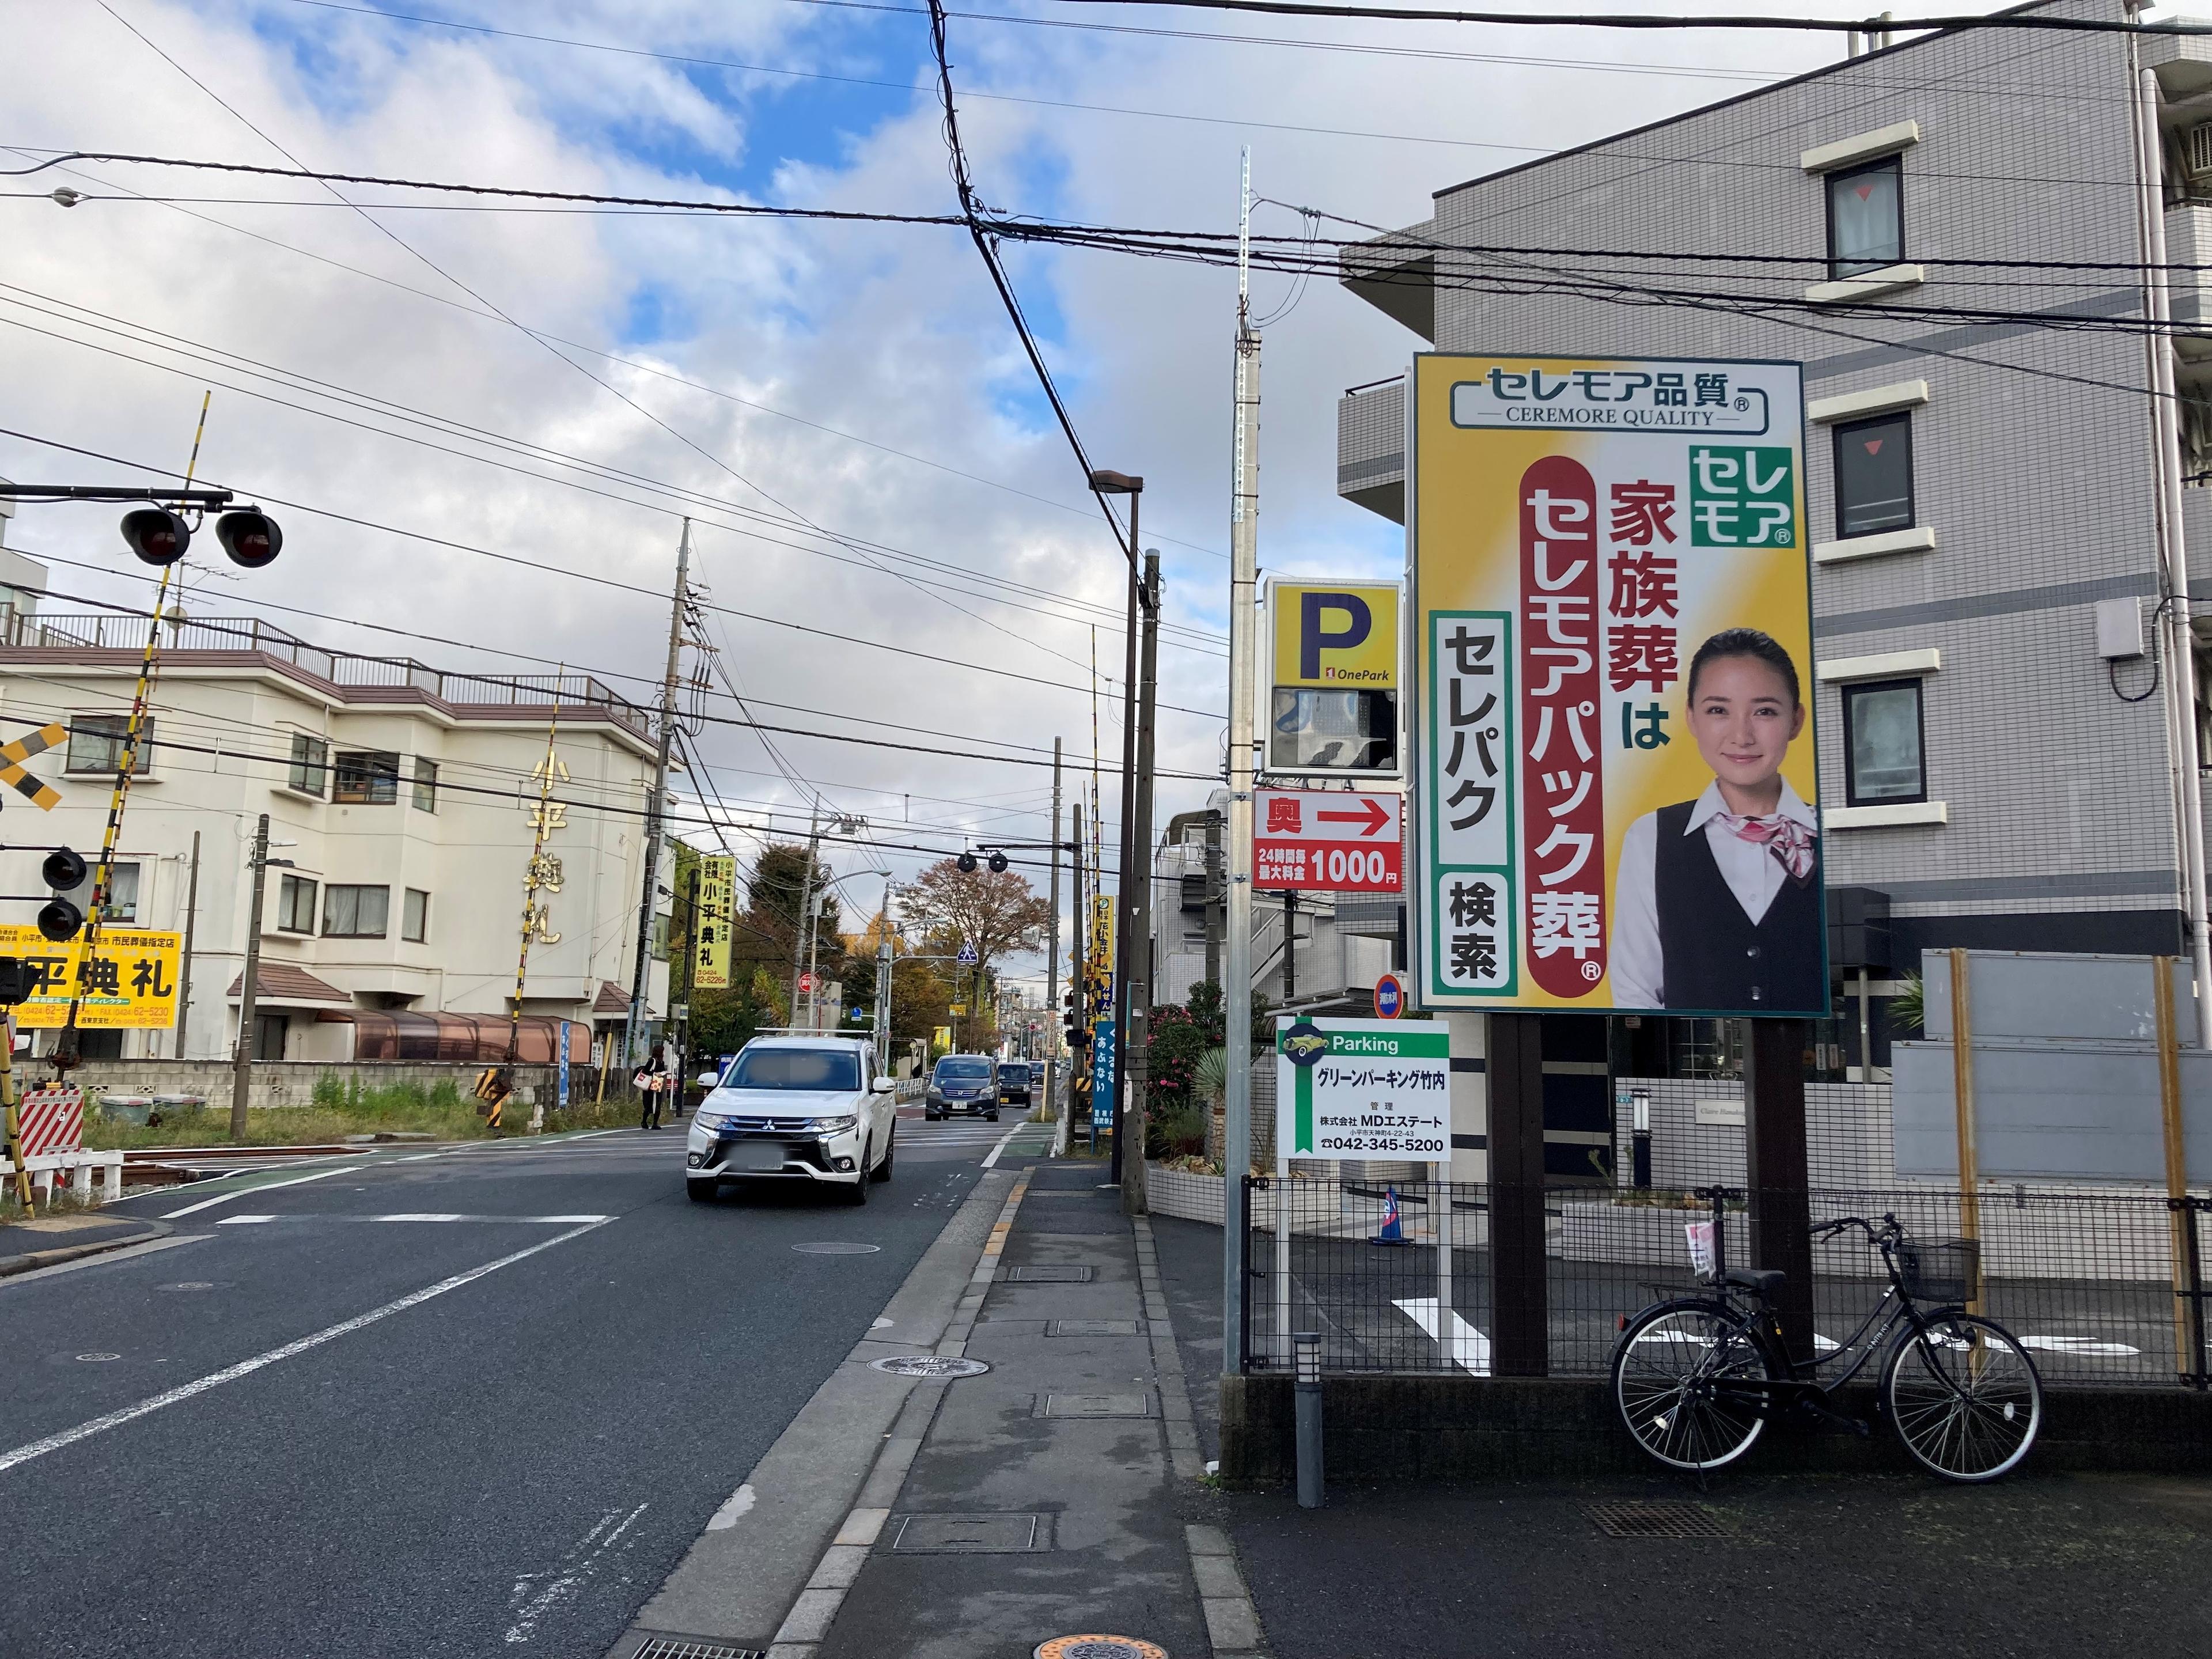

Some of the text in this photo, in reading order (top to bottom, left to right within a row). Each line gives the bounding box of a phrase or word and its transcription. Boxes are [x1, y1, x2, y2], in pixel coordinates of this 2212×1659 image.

[1487, 368, 1729, 407] セレモア品質
[1506, 407, 1714, 426] CEREMORE QUALITY
[1607, 479, 1679, 750] 家族葬は
[1300, 592, 1372, 680] P
[1338, 669, 1389, 681] OnePark
[1444, 626, 1498, 831] セレパク
[1525, 488, 1601, 960] セレモアパック葬
[1266, 797, 1302, 834] 奥
[1258, 848, 1306, 865] 24時間毎
[1258, 864, 1306, 881] 最大料金
[699, 882, 717, 966] 小平典礼
[1449, 881, 1498, 979] 検索
[1332, 1035, 1399, 1055] Parking
[1097, 1036, 1107, 1092] あぶない
[1317, 1067, 1445, 1090] グリーンパーキング竹内
[1320, 1114, 1443, 1128] 株式会社 MDエステート
[1333, 1137, 1444, 1152] 042-345-5200
